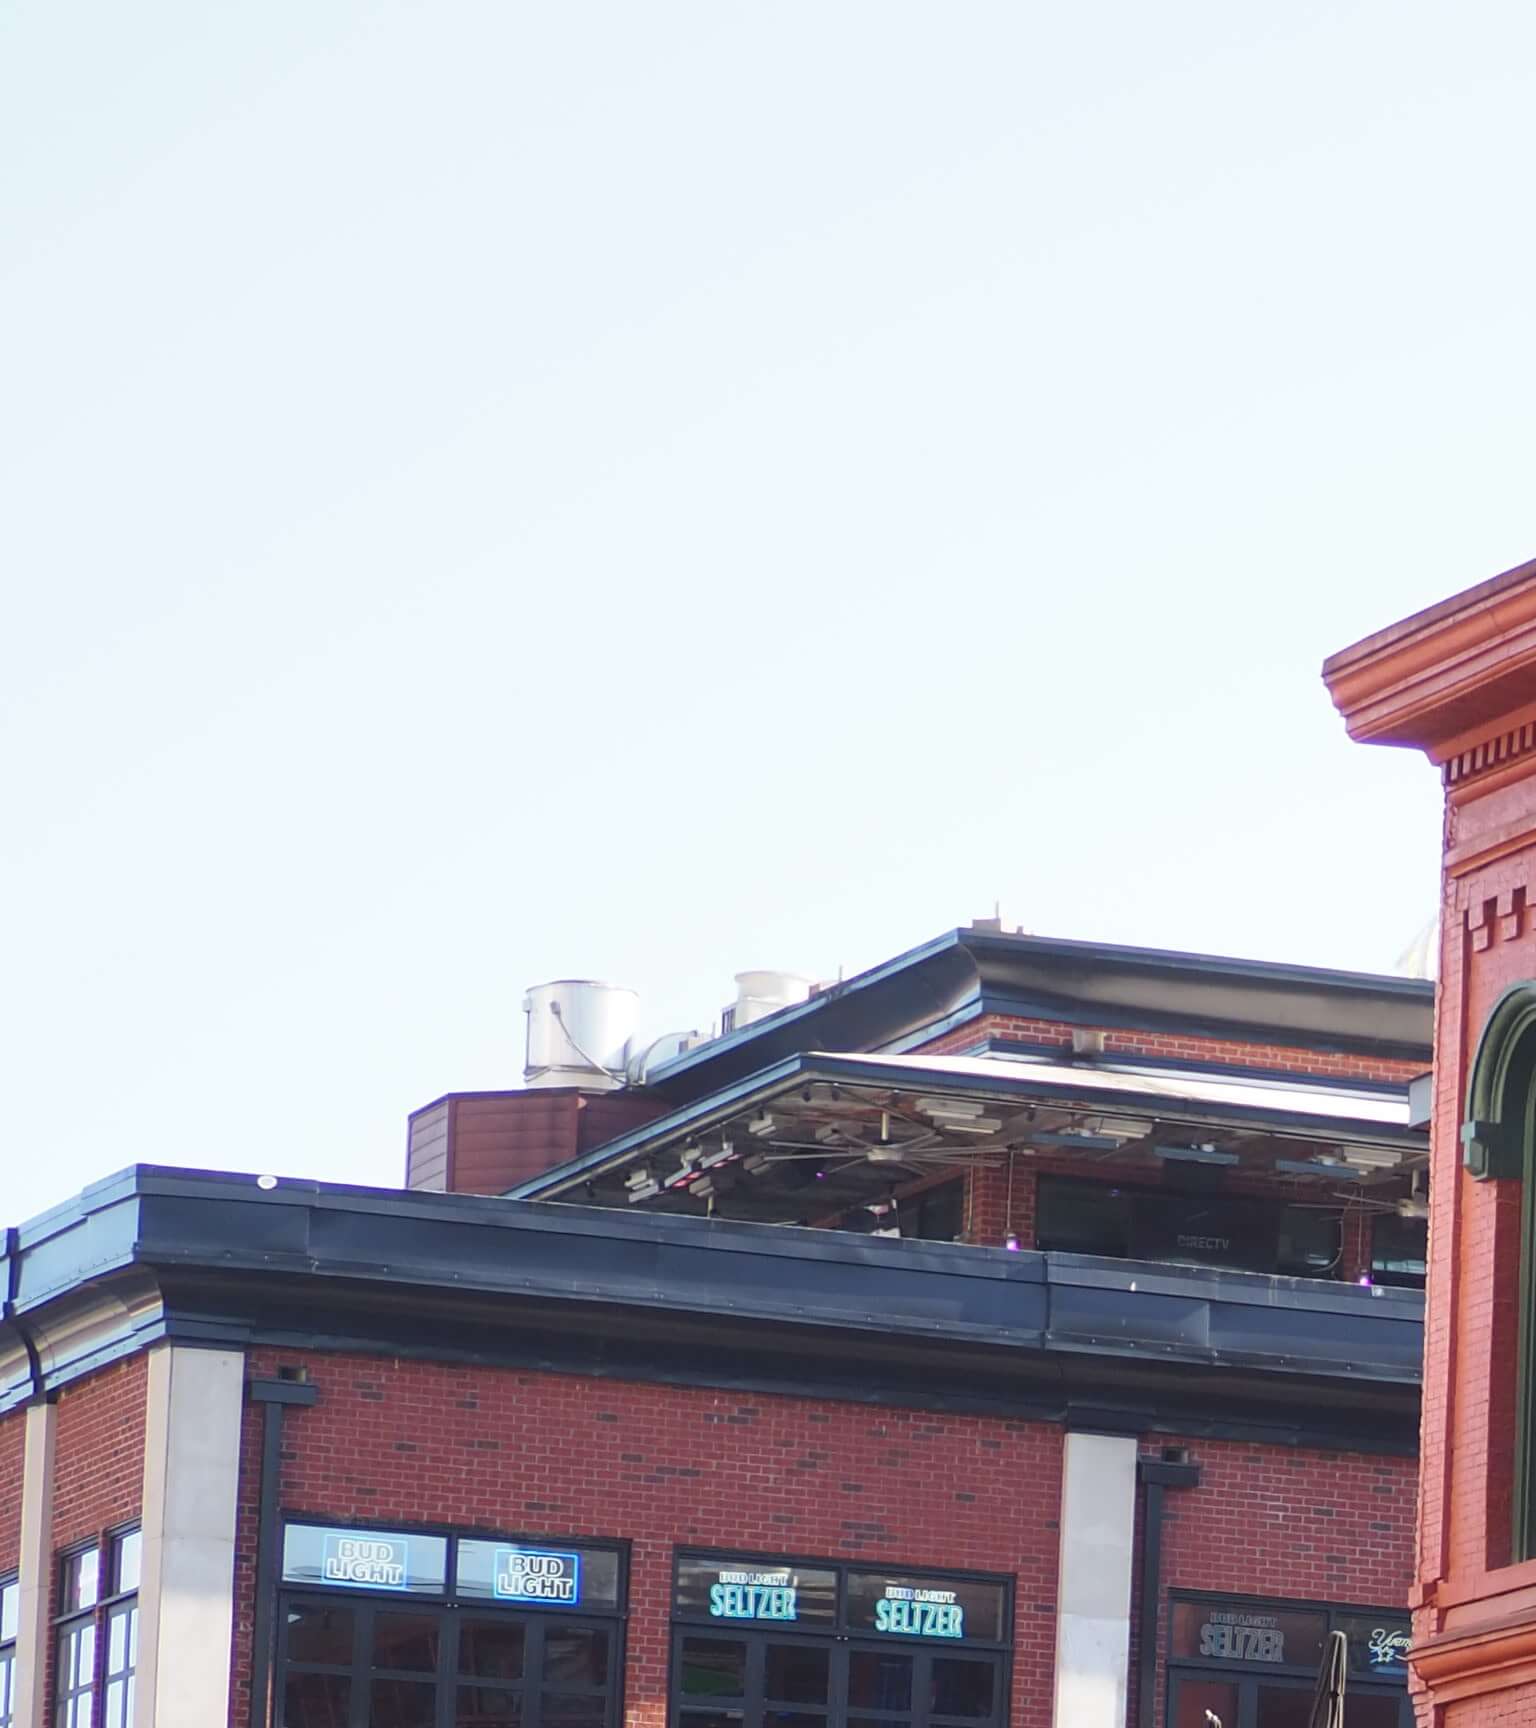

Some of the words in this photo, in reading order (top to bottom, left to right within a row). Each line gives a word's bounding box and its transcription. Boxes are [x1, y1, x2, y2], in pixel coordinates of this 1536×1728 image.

[338, 1538, 393, 1563] BUD
[325, 1557, 402, 1585] LIGHT
[509, 1554, 564, 1577] BUD
[495, 1573, 573, 1600] LIGHT
[710, 1583, 797, 1621] SELTZER
[875, 1599, 963, 1638] SELTZER
[1200, 1623, 1284, 1663] SELTZER
